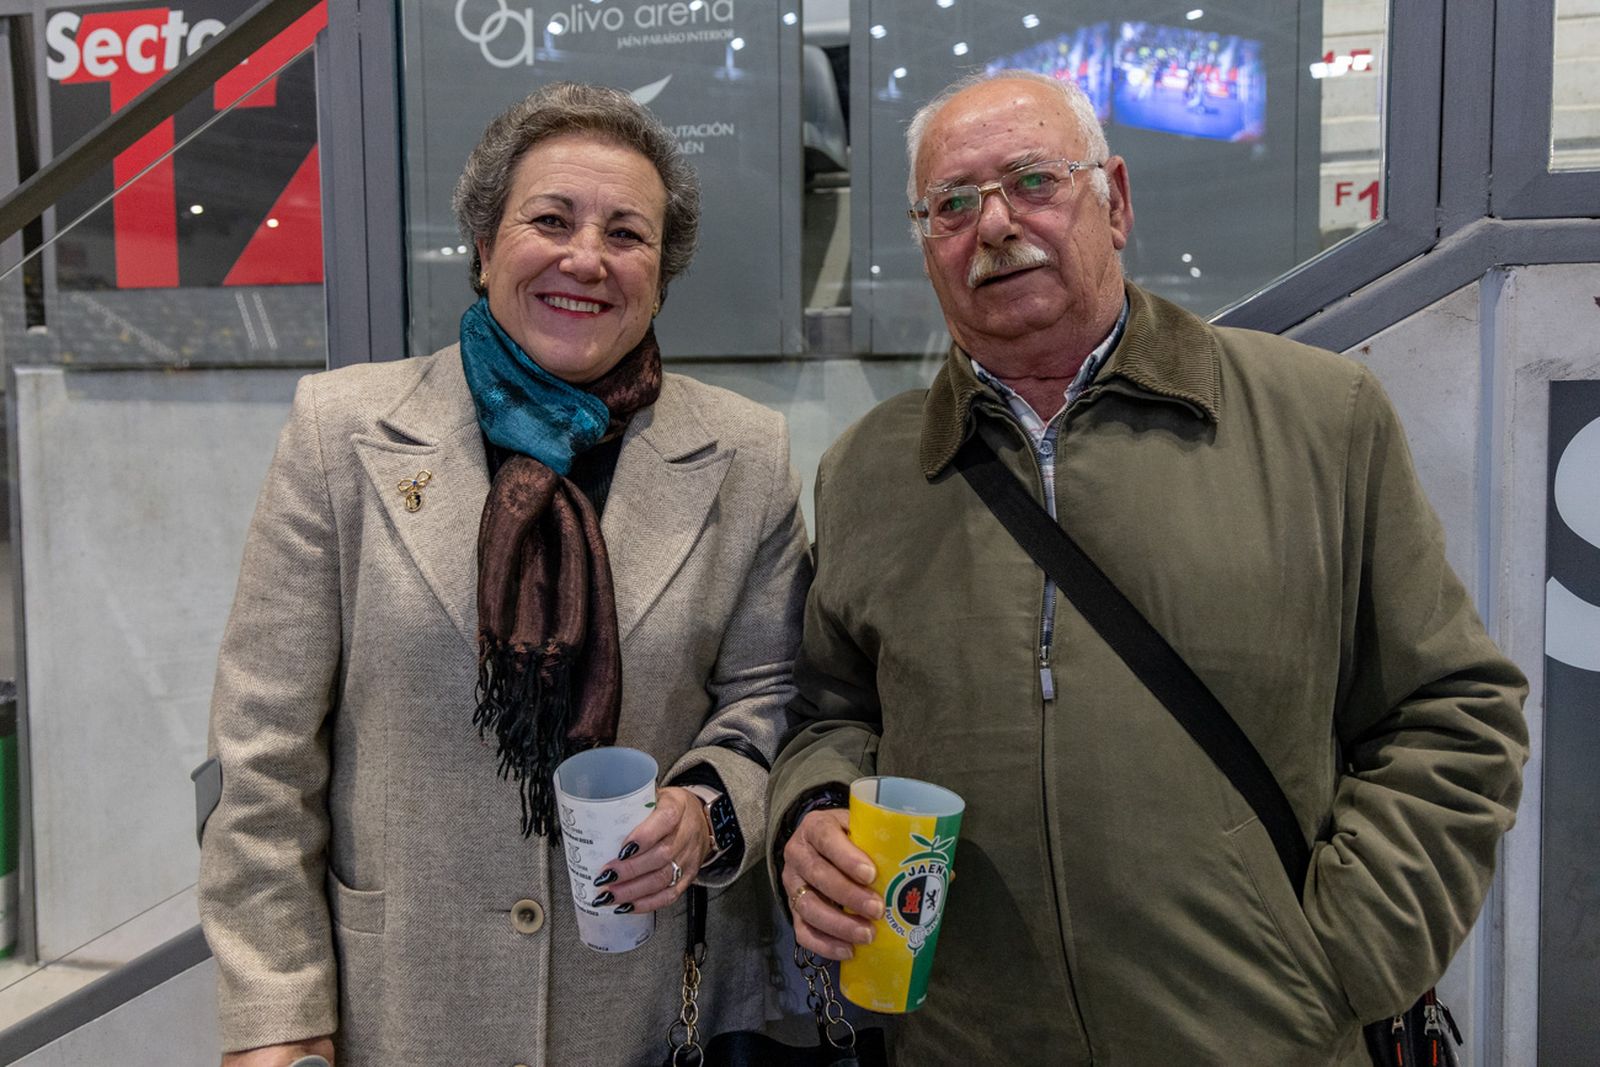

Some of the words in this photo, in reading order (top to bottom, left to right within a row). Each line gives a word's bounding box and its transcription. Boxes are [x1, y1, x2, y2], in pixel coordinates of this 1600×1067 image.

[547, 3, 624, 36] olivo
[634, 0, 735, 29] arena
[46, 10, 248, 80] Secto
[672, 121, 735, 137] UTACIÓN
[676, 140, 705, 154] AÉN
